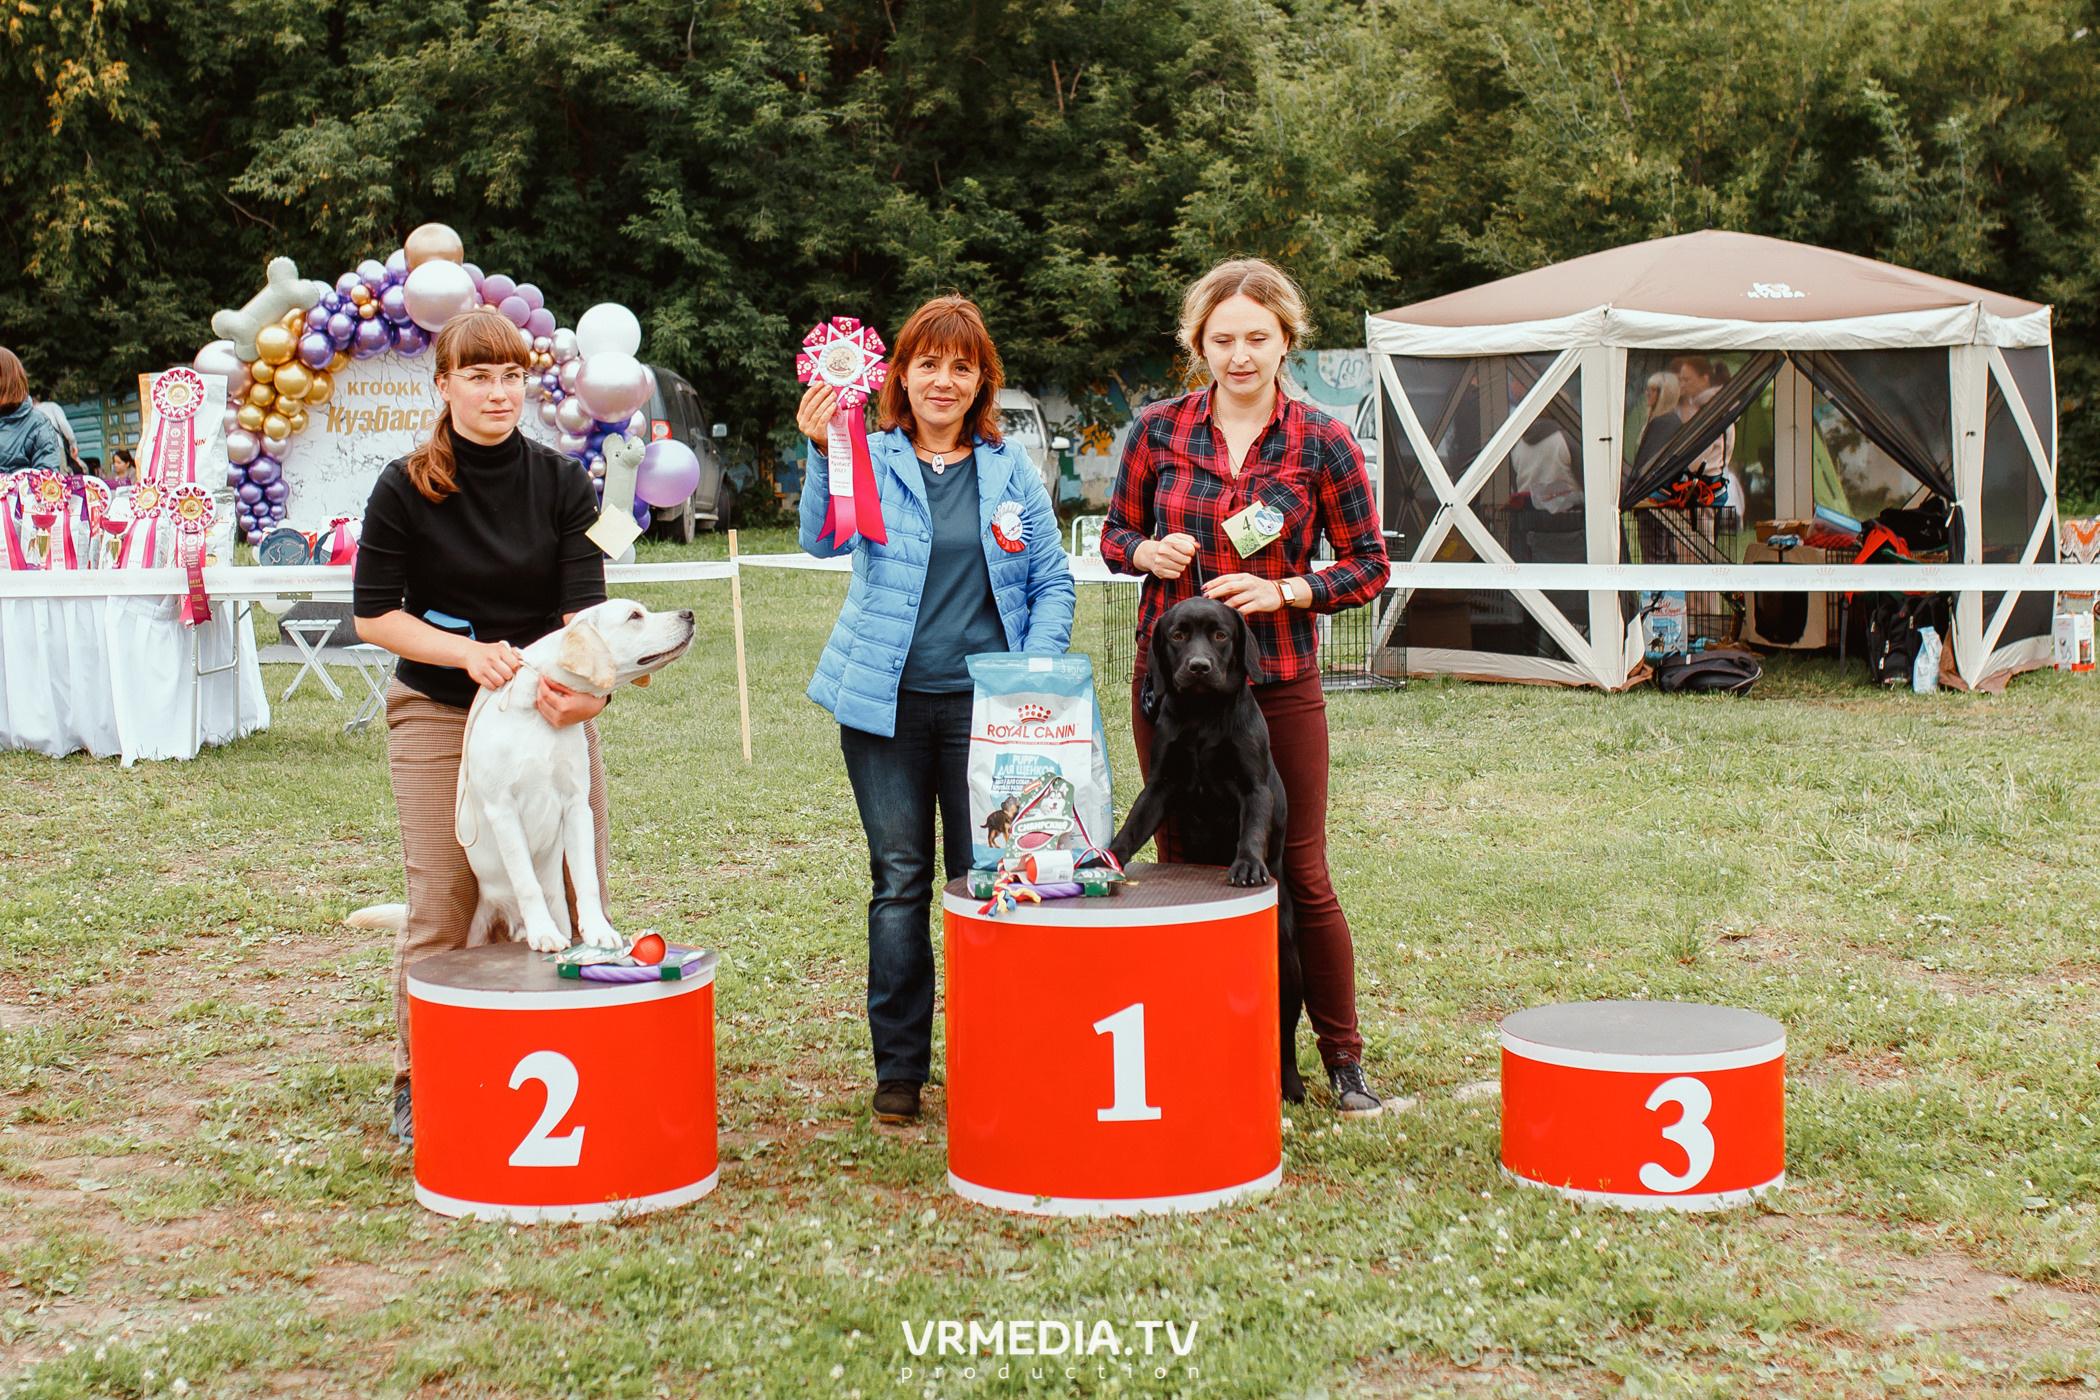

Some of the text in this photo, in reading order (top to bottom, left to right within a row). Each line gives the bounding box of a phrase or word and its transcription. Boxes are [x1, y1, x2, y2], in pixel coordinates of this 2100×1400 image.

[326, 405, 436, 436] Кузбасс
[1242, 515, 1251, 531] 4
[987, 723, 1076, 739] ROYAL CANIN
[998, 764, 1055, 777] ДЛЯ ЩЕНКОВ
[1012, 754, 1040, 765] PUPPY
[1093, 1002, 1162, 1121] 1
[508, 1050, 586, 1167] 2
[1638, 1075, 1715, 1193] 3
